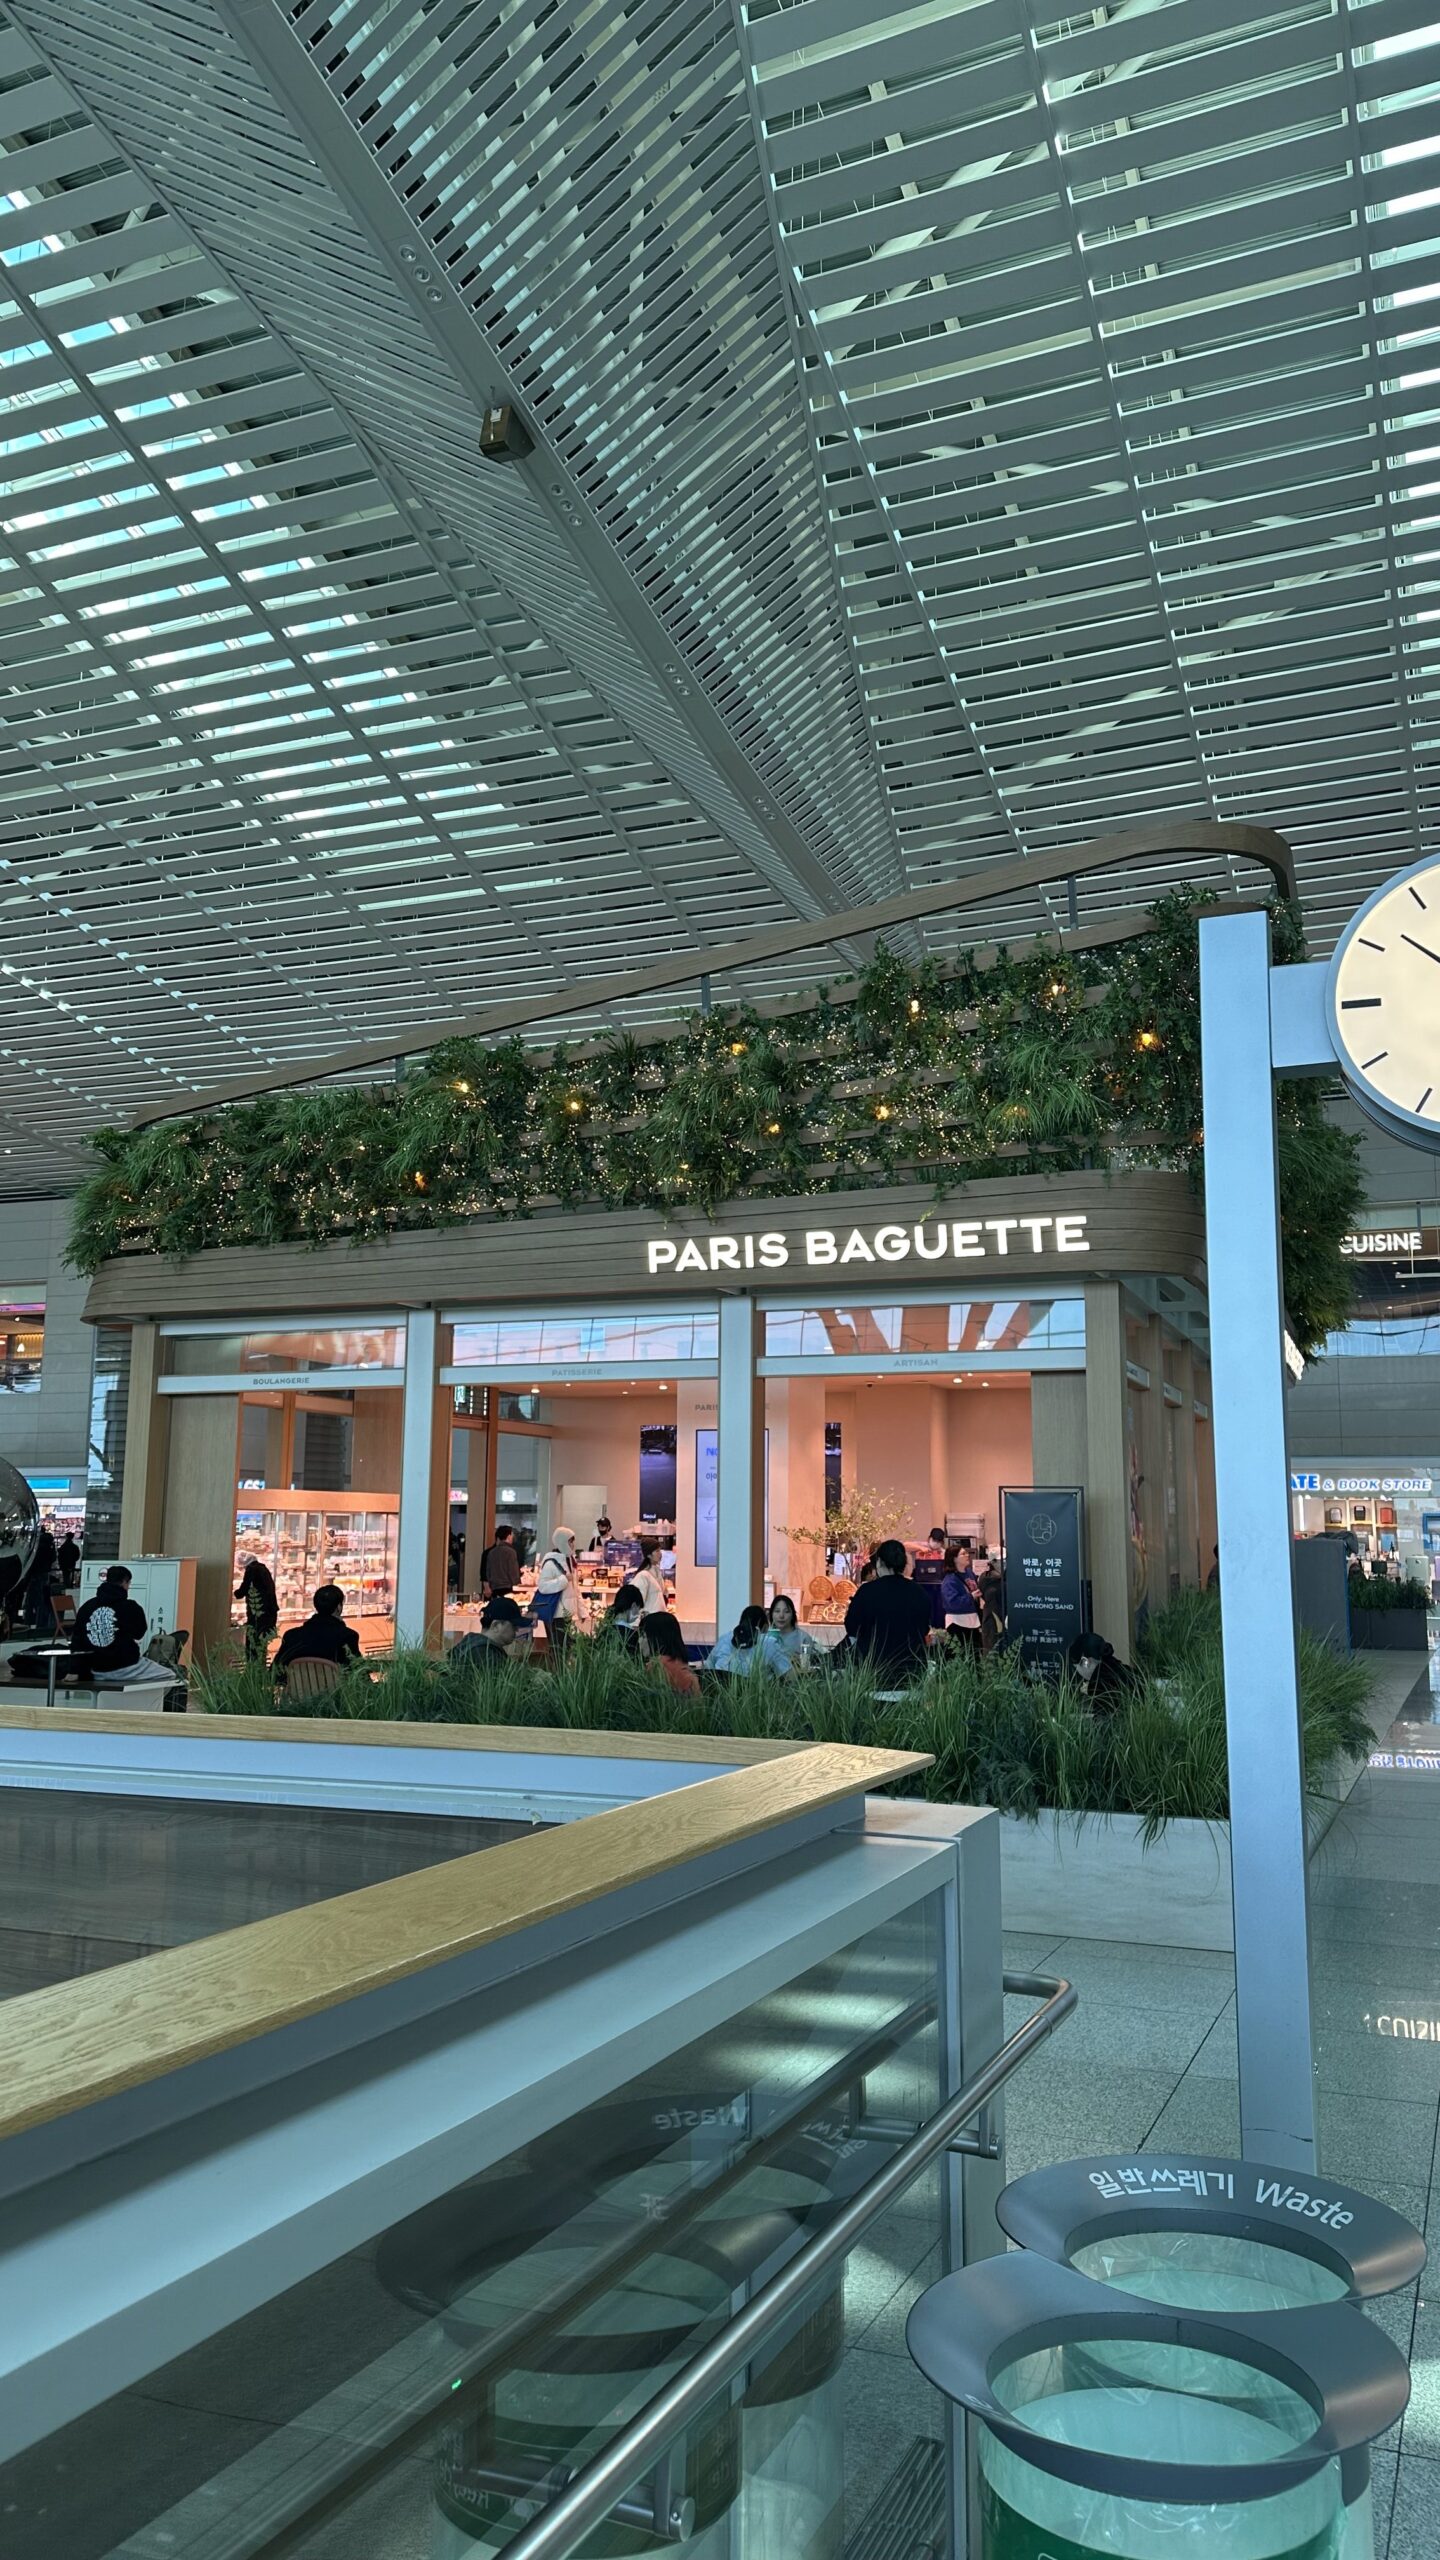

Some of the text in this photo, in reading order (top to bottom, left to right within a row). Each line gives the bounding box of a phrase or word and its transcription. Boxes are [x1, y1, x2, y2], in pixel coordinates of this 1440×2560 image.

[647, 1215, 1091, 1274] PARIS BAGUETTE
[1338, 1232, 1423, 1254] CUISINE
[893, 1358, 939, 1367] ARTISAN
[551, 1368, 603, 1377] PATISSERIE
[252, 1376, 311, 1386] BOULANGERIE
[1323, 1479, 1335, 1490] &
[1337, 1478, 1380, 1491] BOOK
[1382, 1478, 1432, 1491] STORE
[1054, 1603, 1075, 1611] SAND
[1087, 2168, 1235, 2199] 일반쓰레기
[1254, 2178, 1356, 2230] Waste
